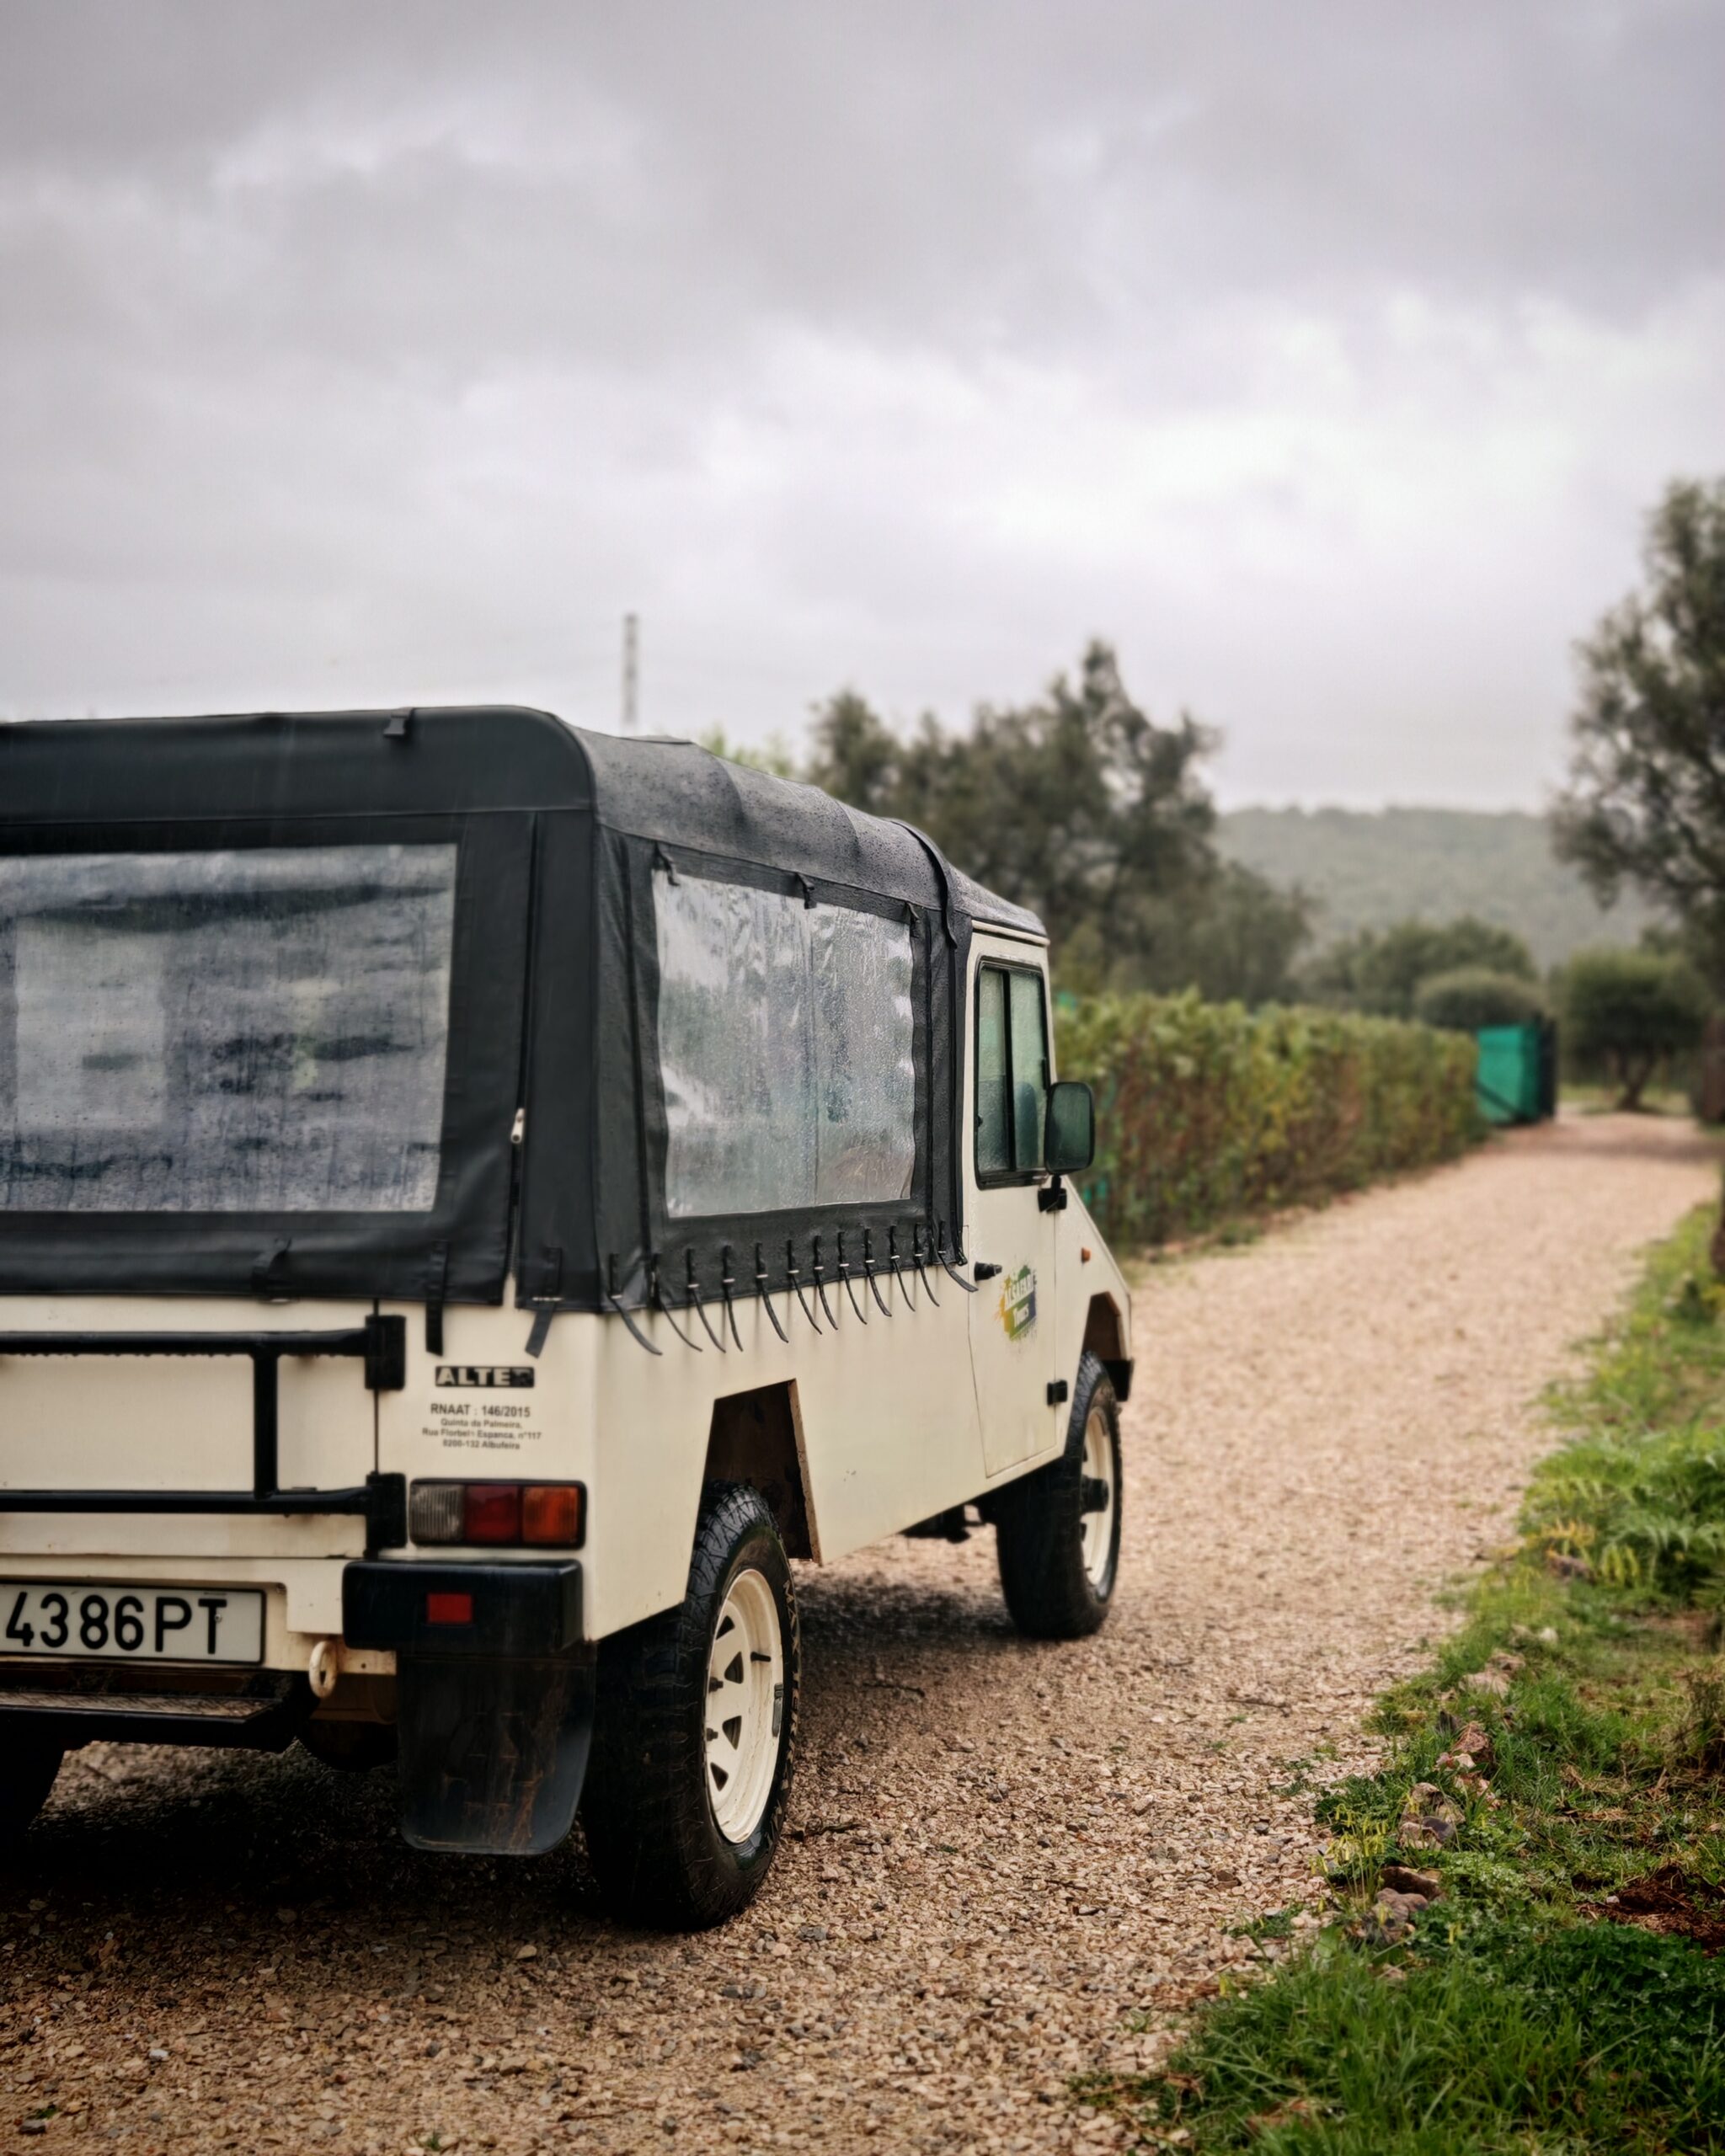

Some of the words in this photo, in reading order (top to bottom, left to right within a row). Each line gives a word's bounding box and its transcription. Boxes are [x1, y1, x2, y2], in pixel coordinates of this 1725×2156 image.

[430, 1403, 470, 1416] RNAAT
[481, 1406, 531, 1417] 146/2015
[441, 1418, 468, 1427] Quinta
[471, 1419, 481, 1428] da
[422, 1428, 439, 1437] Rua
[481, 1440, 521, 1450] Albufeira
[6, 1591, 227, 1655] 4386PT
